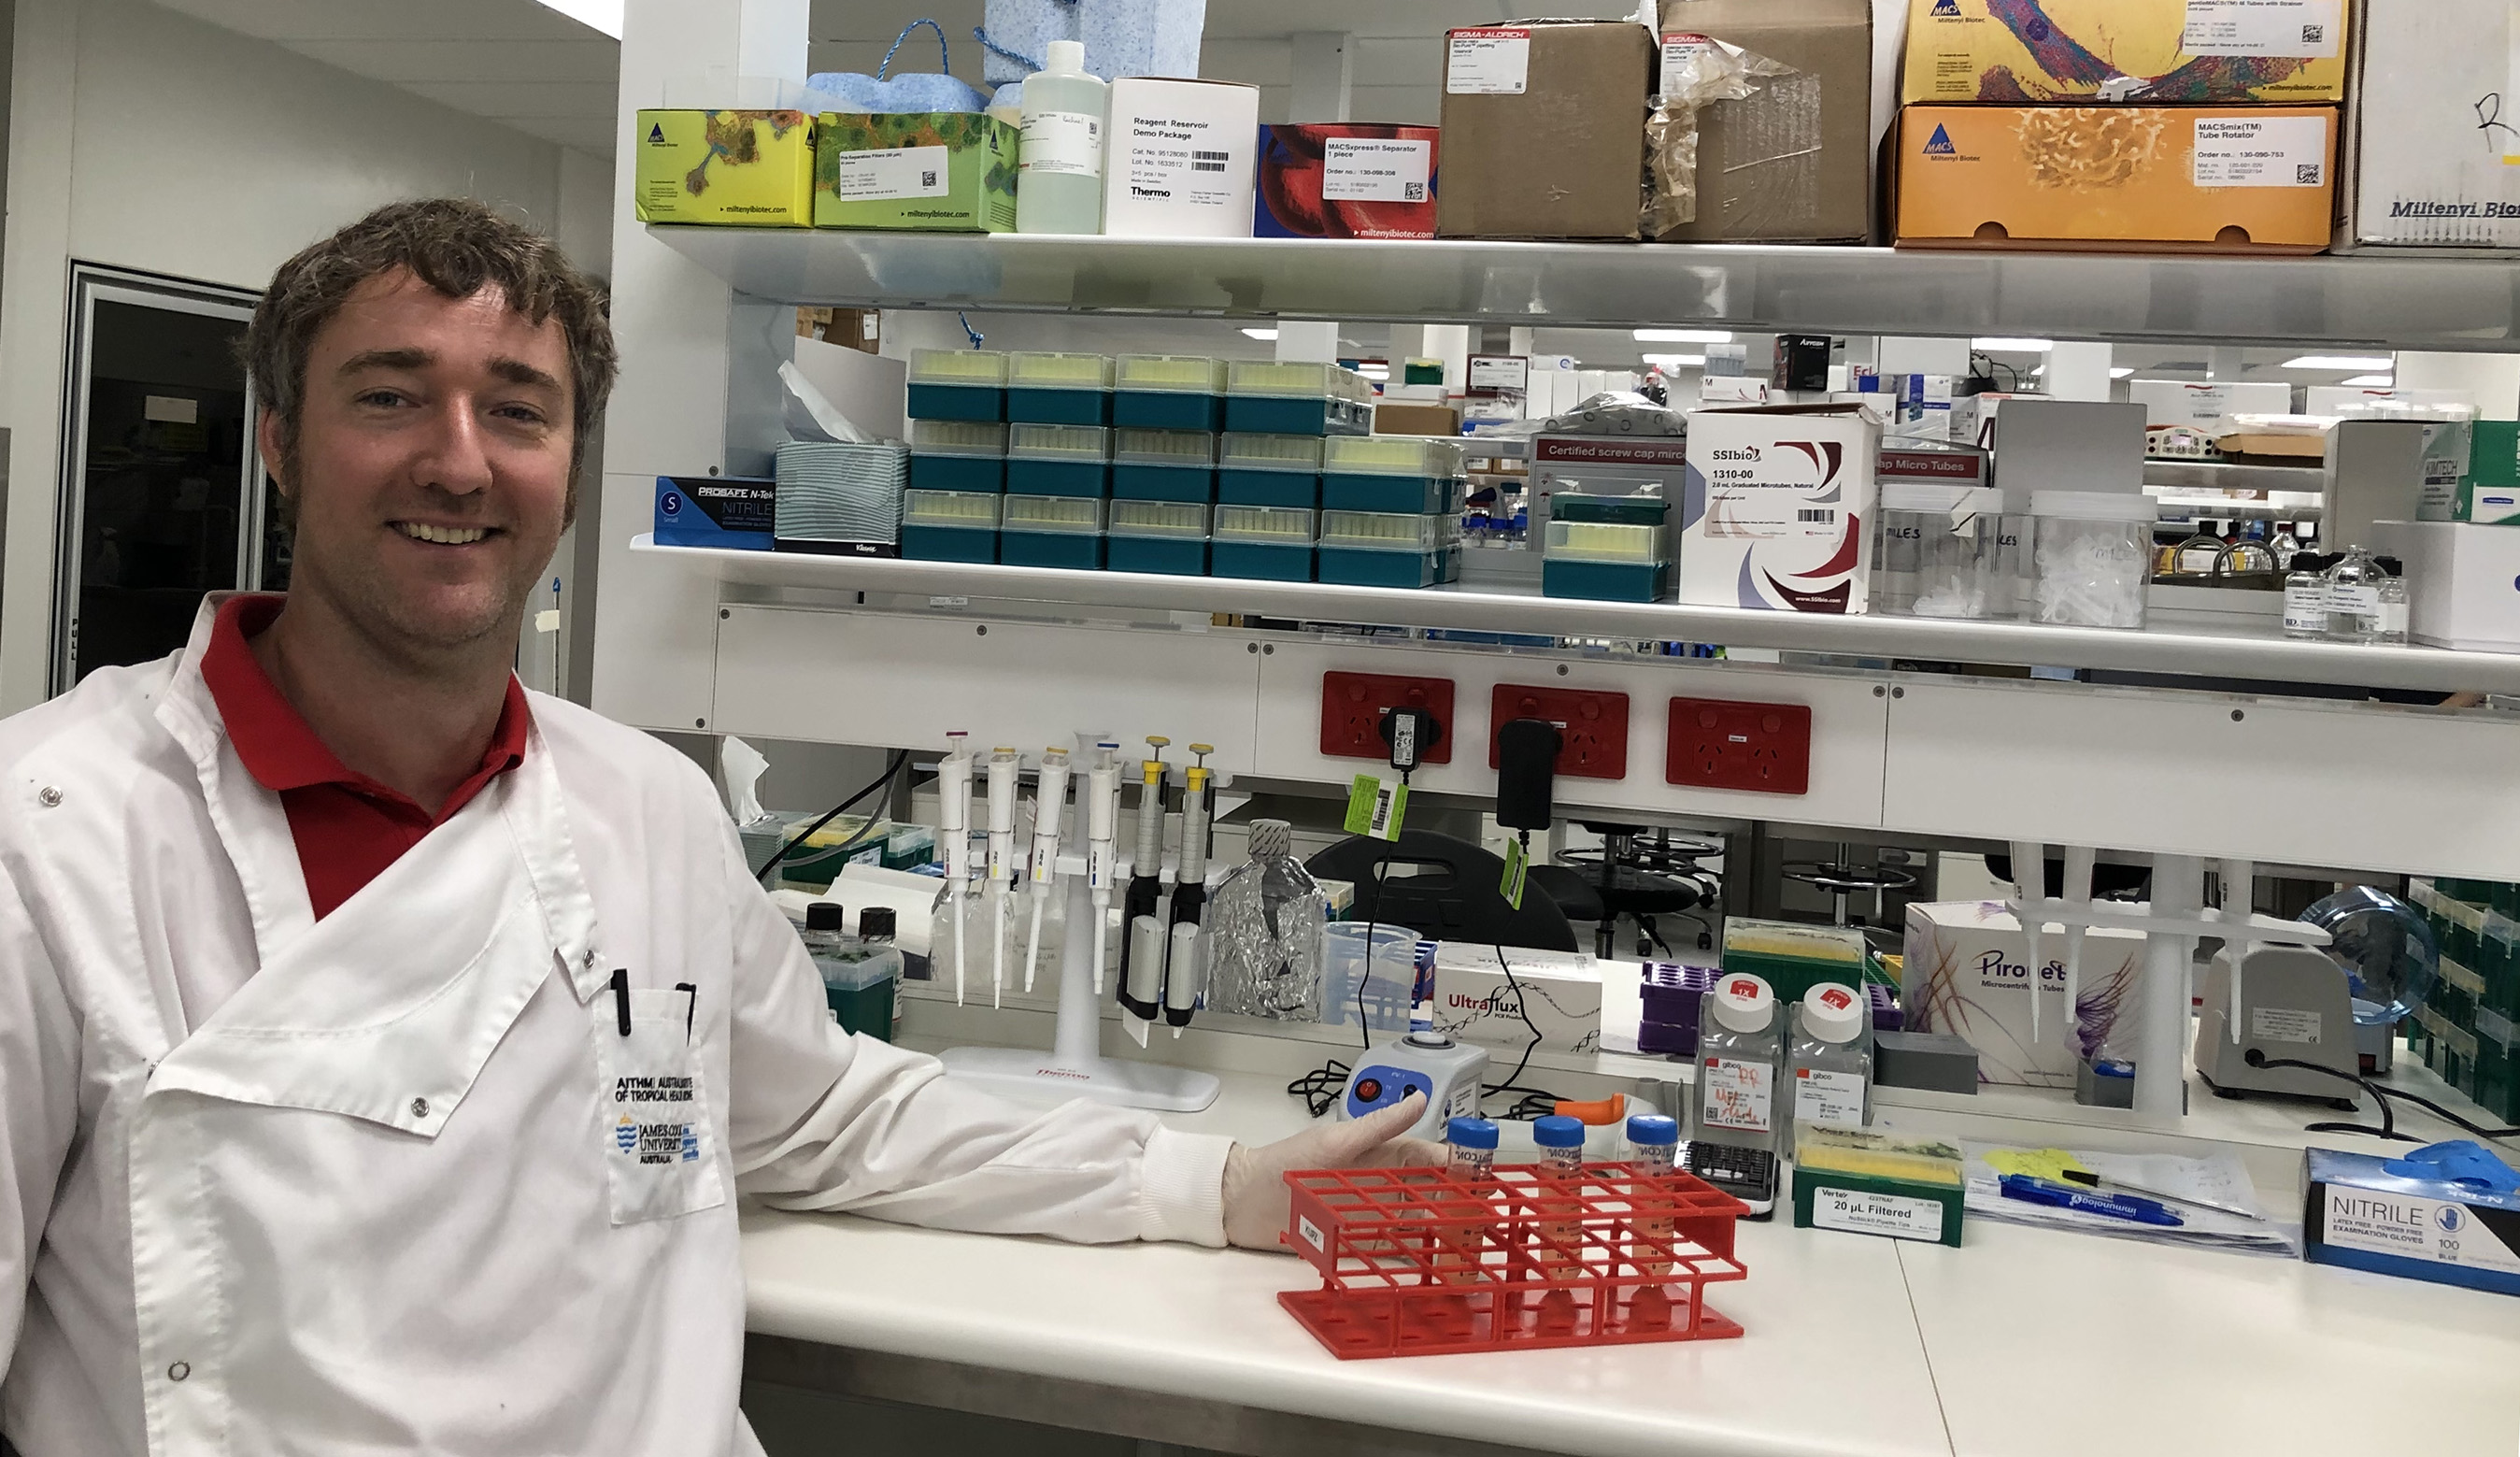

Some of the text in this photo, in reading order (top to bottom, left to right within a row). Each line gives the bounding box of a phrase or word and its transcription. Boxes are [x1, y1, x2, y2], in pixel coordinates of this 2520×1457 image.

[1932, 4, 1959, 16] MACS
[2268, 84, 2333, 93] miltenyibiotec.com
[1133, 117, 1209, 129] Reagent Reservoir
[2198, 123, 2262, 132] MACSmix(TM)
[1133, 129, 1192, 140] Demo Package
[1925, 142, 1955, 153] MACS
[1157, 160, 1183, 168] 1633512
[1131, 186, 1171, 198] Thermo
[726, 206, 787, 214] miltenyibiotec.com
[907, 209, 970, 220] miltenyibiotec.com
[2388, 201, 2479, 218] Miltenyi
[1360, 228, 1434, 239] miltenyibiotec.com
[1548, 445, 1596, 456] Certified
[1598, 448, 1631, 458] screw
[1634, 449, 1655, 460] cap
[1713, 450, 1753, 461] SSIbio
[1877, 459, 1965, 472] ap Micro Tubes
[1713, 470, 1754, 479] 1310-00
[698, 487, 775, 500] PROSAFE N-Tek
[667, 496, 676, 510] S
[722, 502, 774, 515] NITRILE
[1972, 949, 2067, 981] Piroet
[1981, 979, 2065, 993] Microcentrif Tubes
[1738, 988, 1750, 997] 1X
[1448, 990, 1519, 1017] Ultraflux
[1828, 997, 1841, 1007] 1X
[1722, 1061, 1742, 1070] gibco
[1813, 1072, 1832, 1081] gibco
[615, 1090, 628, 1103] OF
[630, 1090, 668, 1103] TROPICAL
[1833, 1200, 1912, 1219] 20 µL Filtered
[2333, 1195, 2424, 1226] NITRILE
[2333, 1217, 2424, 1236] LATEX FREE POWDER FREE
[2333, 1224, 2388, 1239] EXAMINATION
[2389, 1231, 2424, 1245] GLOVES
[2438, 1238, 2459, 1250] 100
[2438, 1252, 2457, 1262] BLUE
